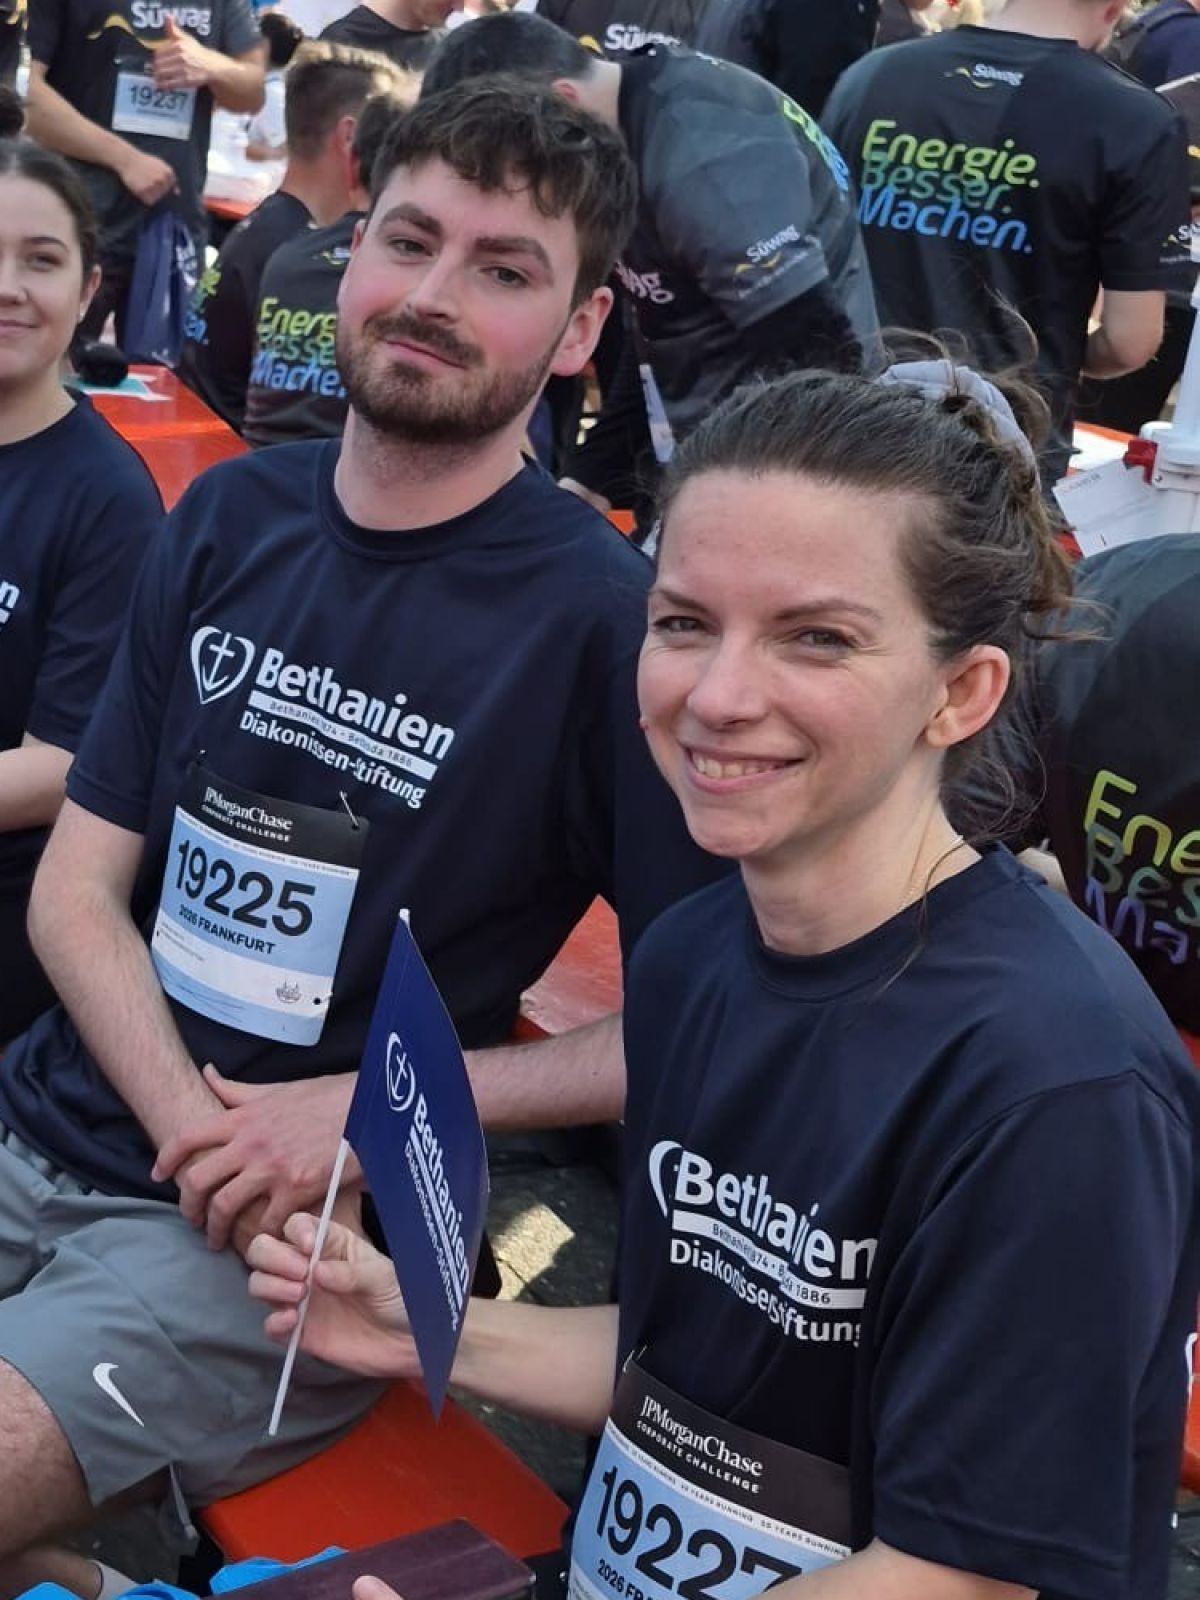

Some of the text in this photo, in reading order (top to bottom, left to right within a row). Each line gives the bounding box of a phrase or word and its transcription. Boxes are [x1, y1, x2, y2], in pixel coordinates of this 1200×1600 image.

[862, 119, 1040, 188] Energie.
[856, 183, 1033, 254] Machen.
[256, 648, 455, 760] Bethanien
[240, 711, 426, 808] Diakonissen-Stiftung
[176, 839, 317, 937] 19225
[198, 916, 276, 954] FRANKFURT
[413, 1093, 470, 1294] Bethanien
[637, 1420, 683, 1457] CORPORATE
[686, 1452, 761, 1493] CHALLENGE
[640, 1395, 764, 1476] JPMorganChase
[598, 1558, 625, 1593] 2026
